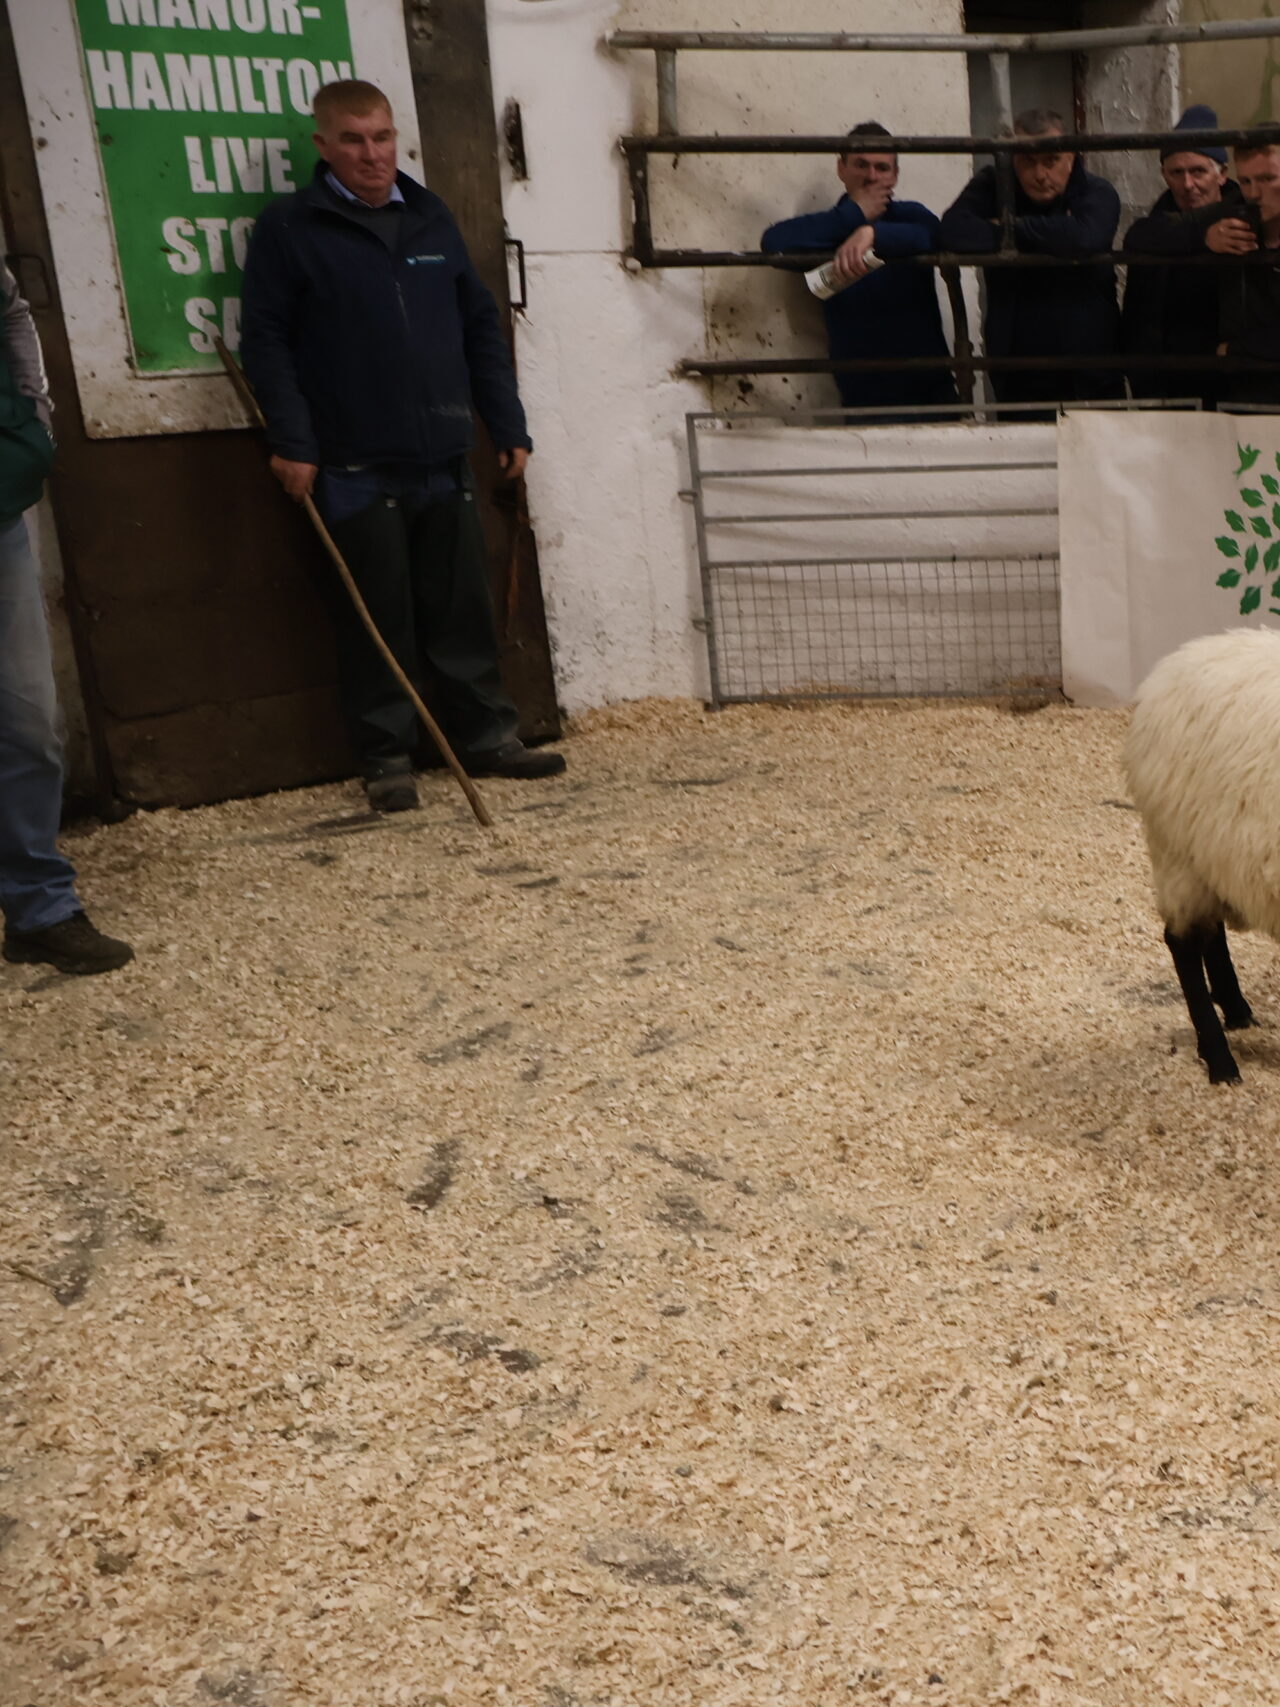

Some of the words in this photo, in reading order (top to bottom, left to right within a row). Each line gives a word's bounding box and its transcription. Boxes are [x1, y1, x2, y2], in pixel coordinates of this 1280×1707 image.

[184, 135, 297, 193] LIVE
[162, 216, 256, 275] STO
[184, 297, 242, 353] SA
